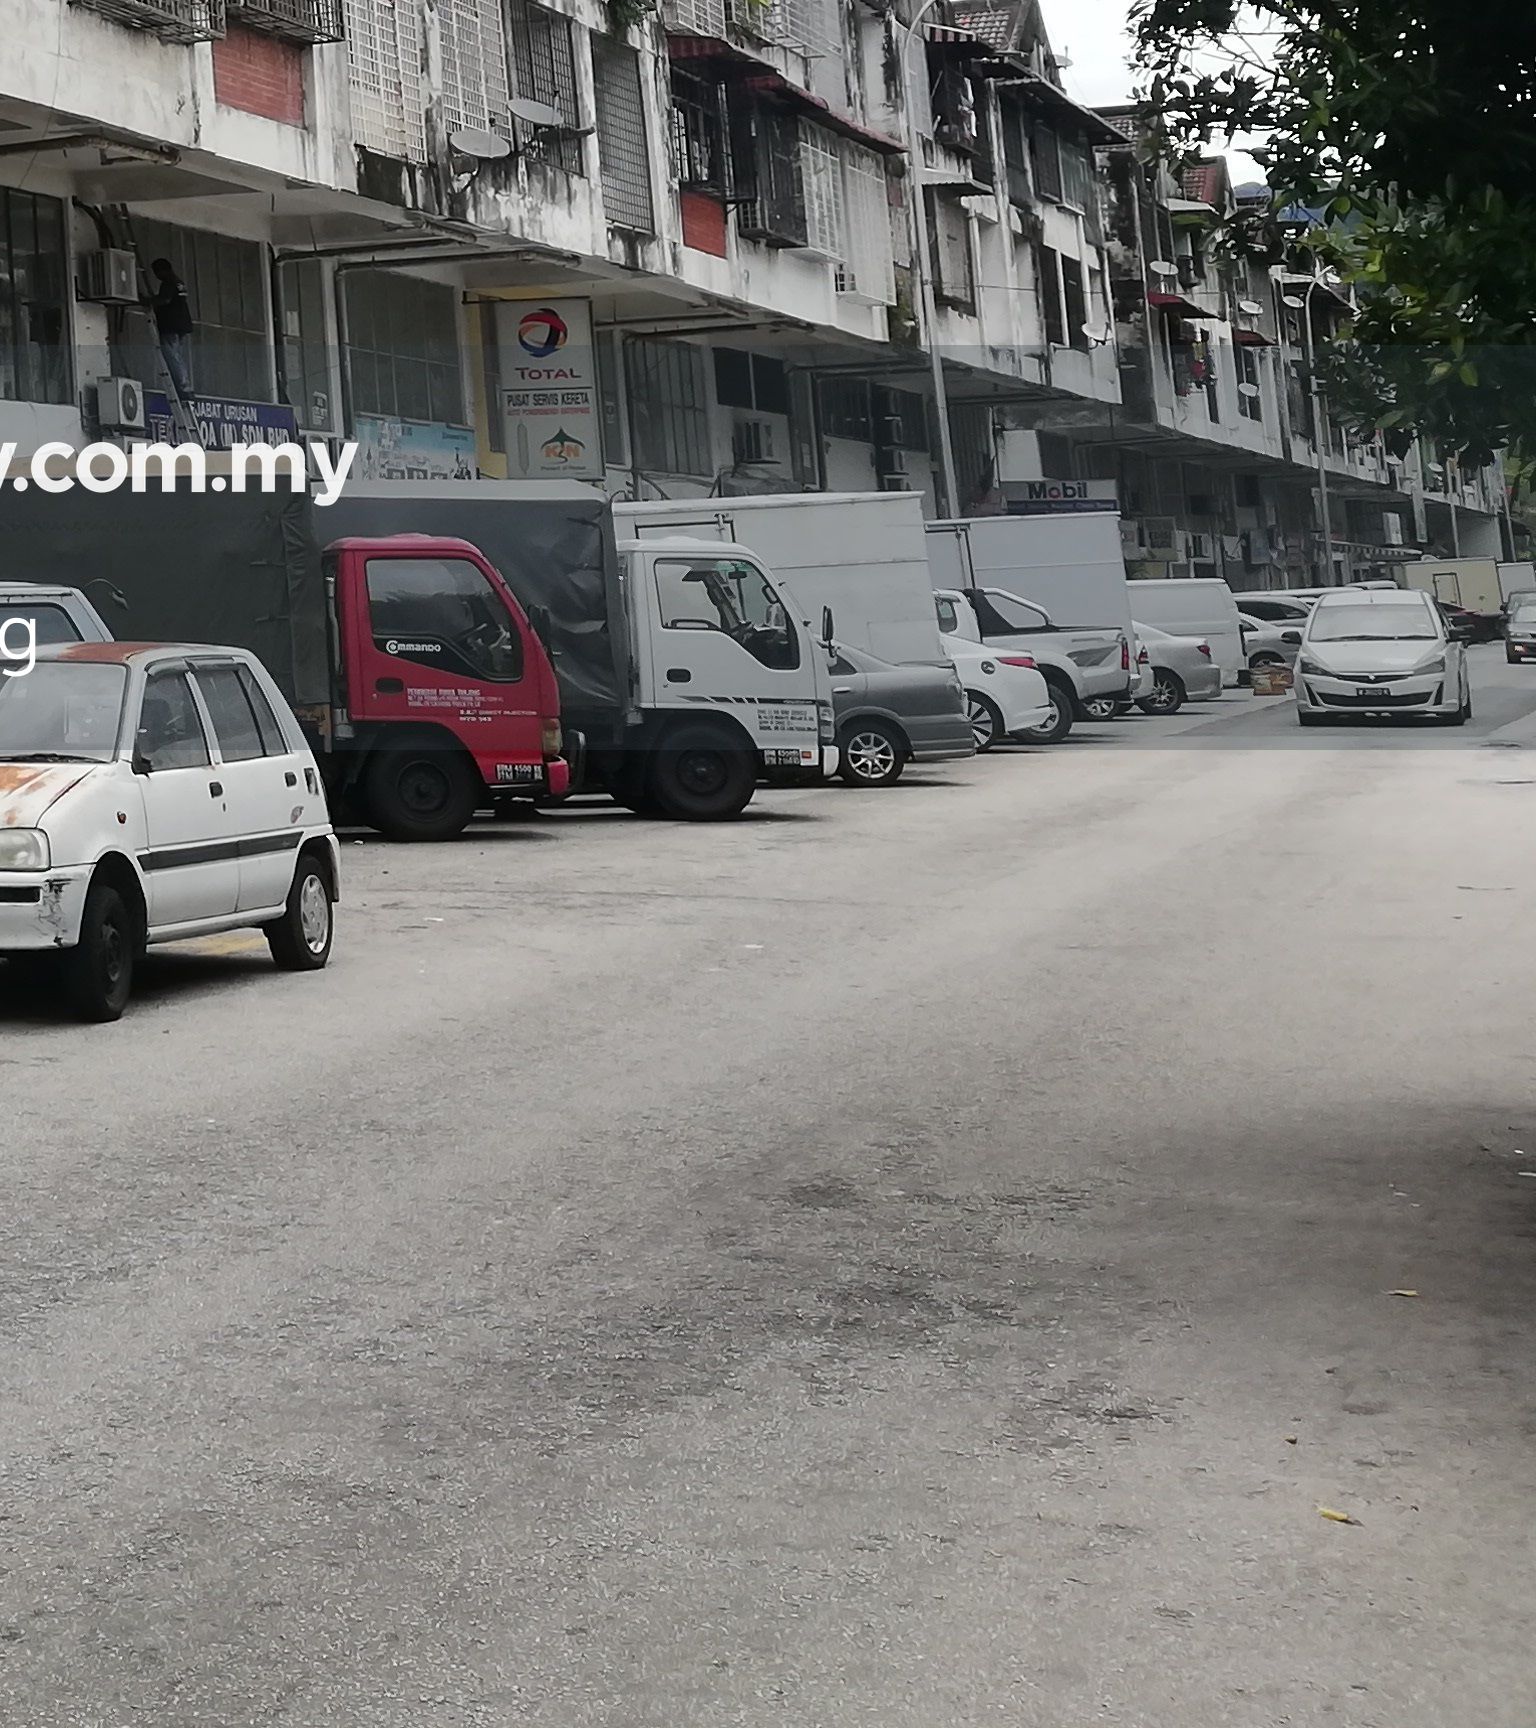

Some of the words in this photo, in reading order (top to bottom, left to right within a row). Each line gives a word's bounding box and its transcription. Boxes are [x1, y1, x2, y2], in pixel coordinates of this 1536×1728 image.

[514, 367, 582, 380] TOTAL
[224, 404, 258, 422] URUSAN
[1028, 481, 1088, 499] Mobil
